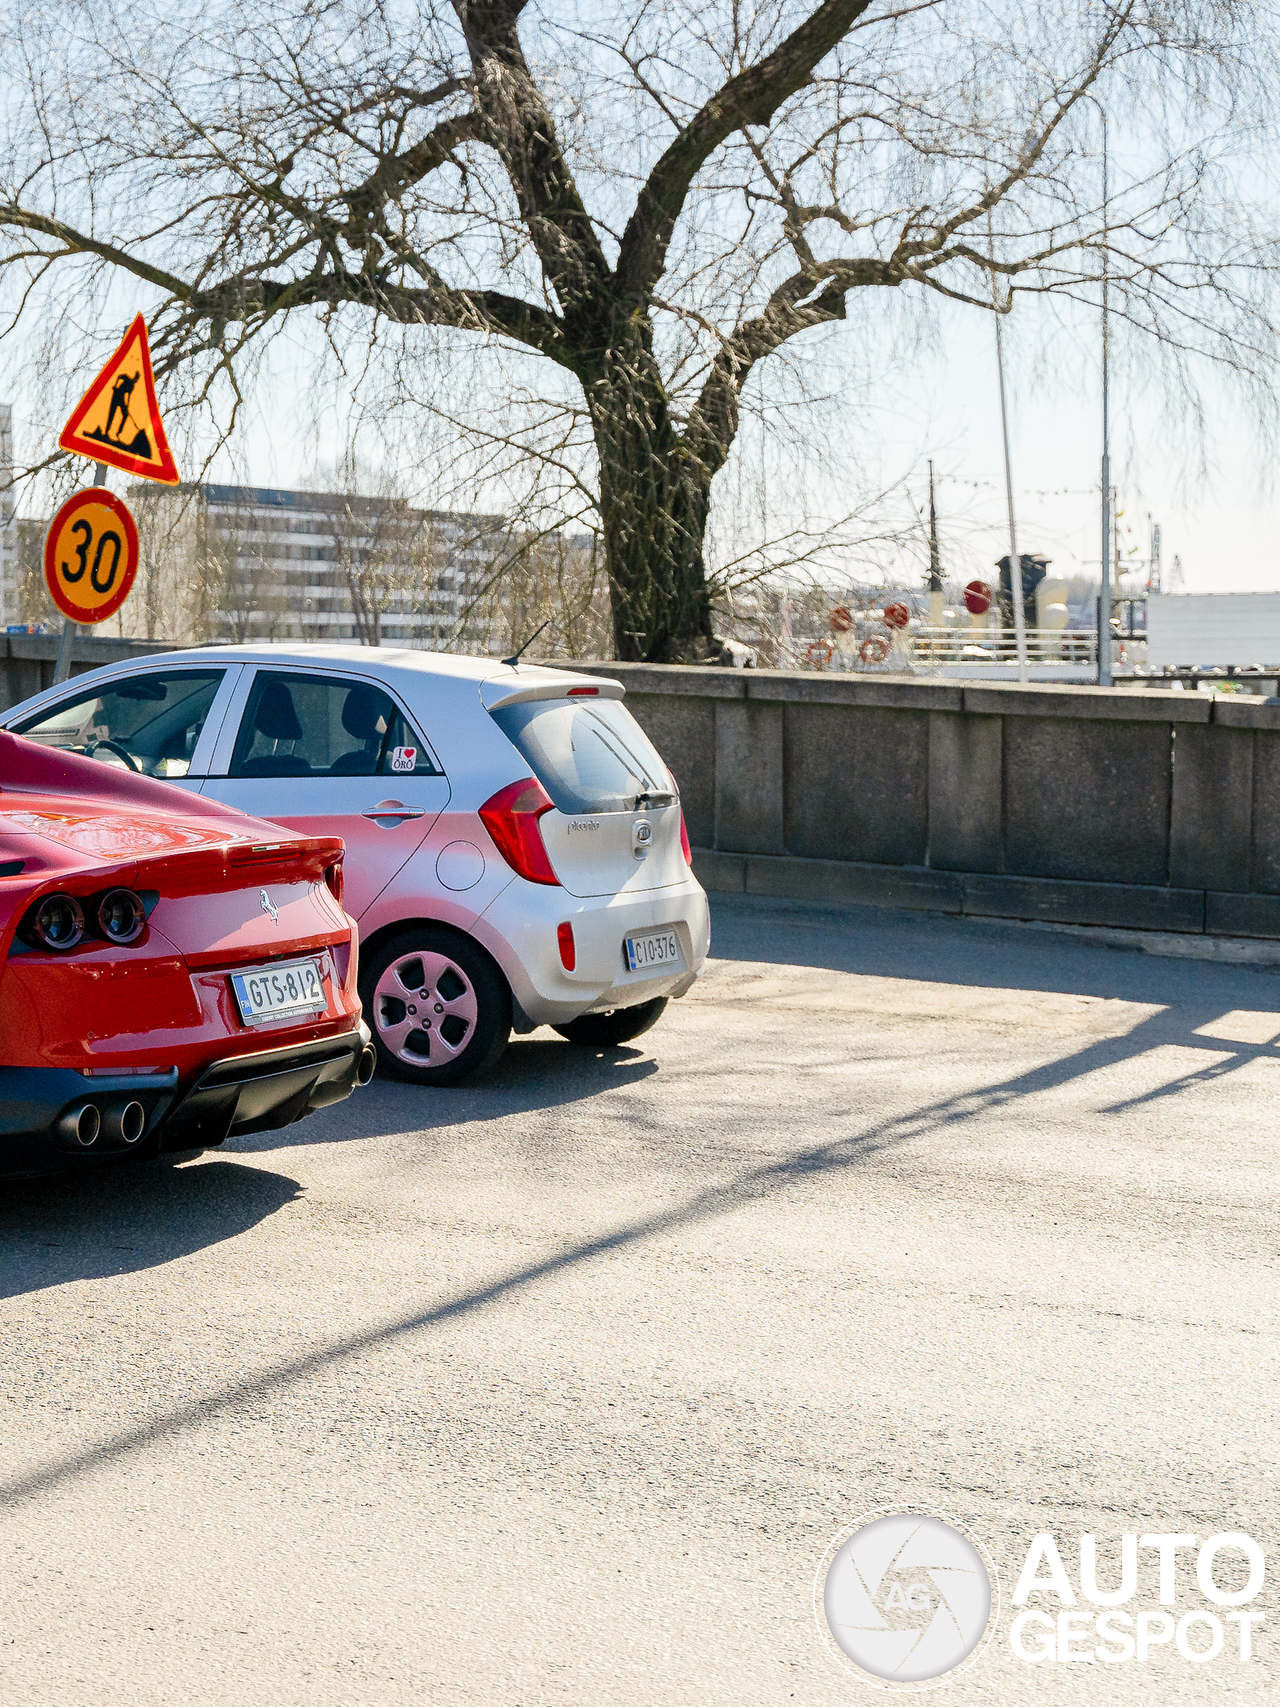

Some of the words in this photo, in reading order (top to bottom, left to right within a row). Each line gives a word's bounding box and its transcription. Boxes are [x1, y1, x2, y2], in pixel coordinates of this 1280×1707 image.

[61, 518, 122, 594] 30
[397, 748, 403, 758] I
[567, 820, 600, 834] picanto
[249, 969, 319, 1007] GTS-812
